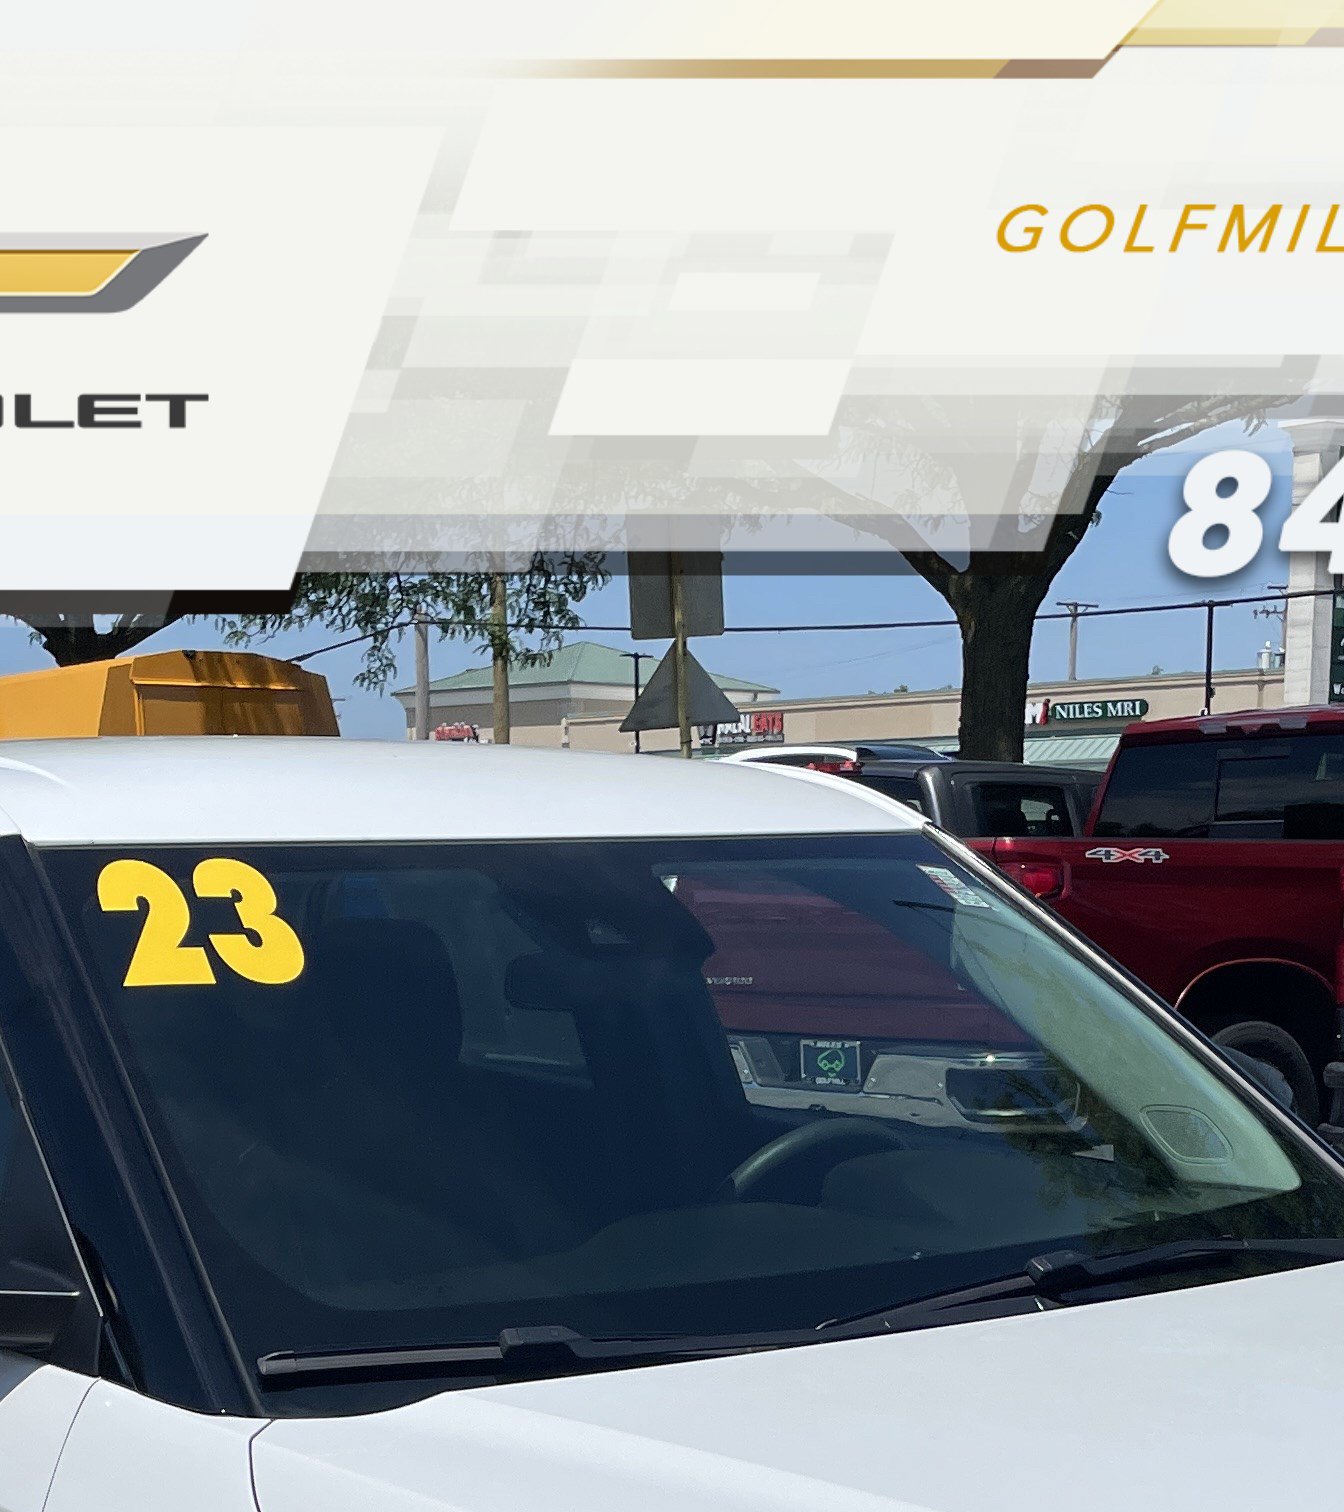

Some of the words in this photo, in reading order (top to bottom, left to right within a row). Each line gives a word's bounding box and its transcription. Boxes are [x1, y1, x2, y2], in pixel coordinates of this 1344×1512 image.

[1055, 703, 1103, 720] NILES
[1107, 700, 1142, 718] MRI
[97, 858, 306, 987] 23
